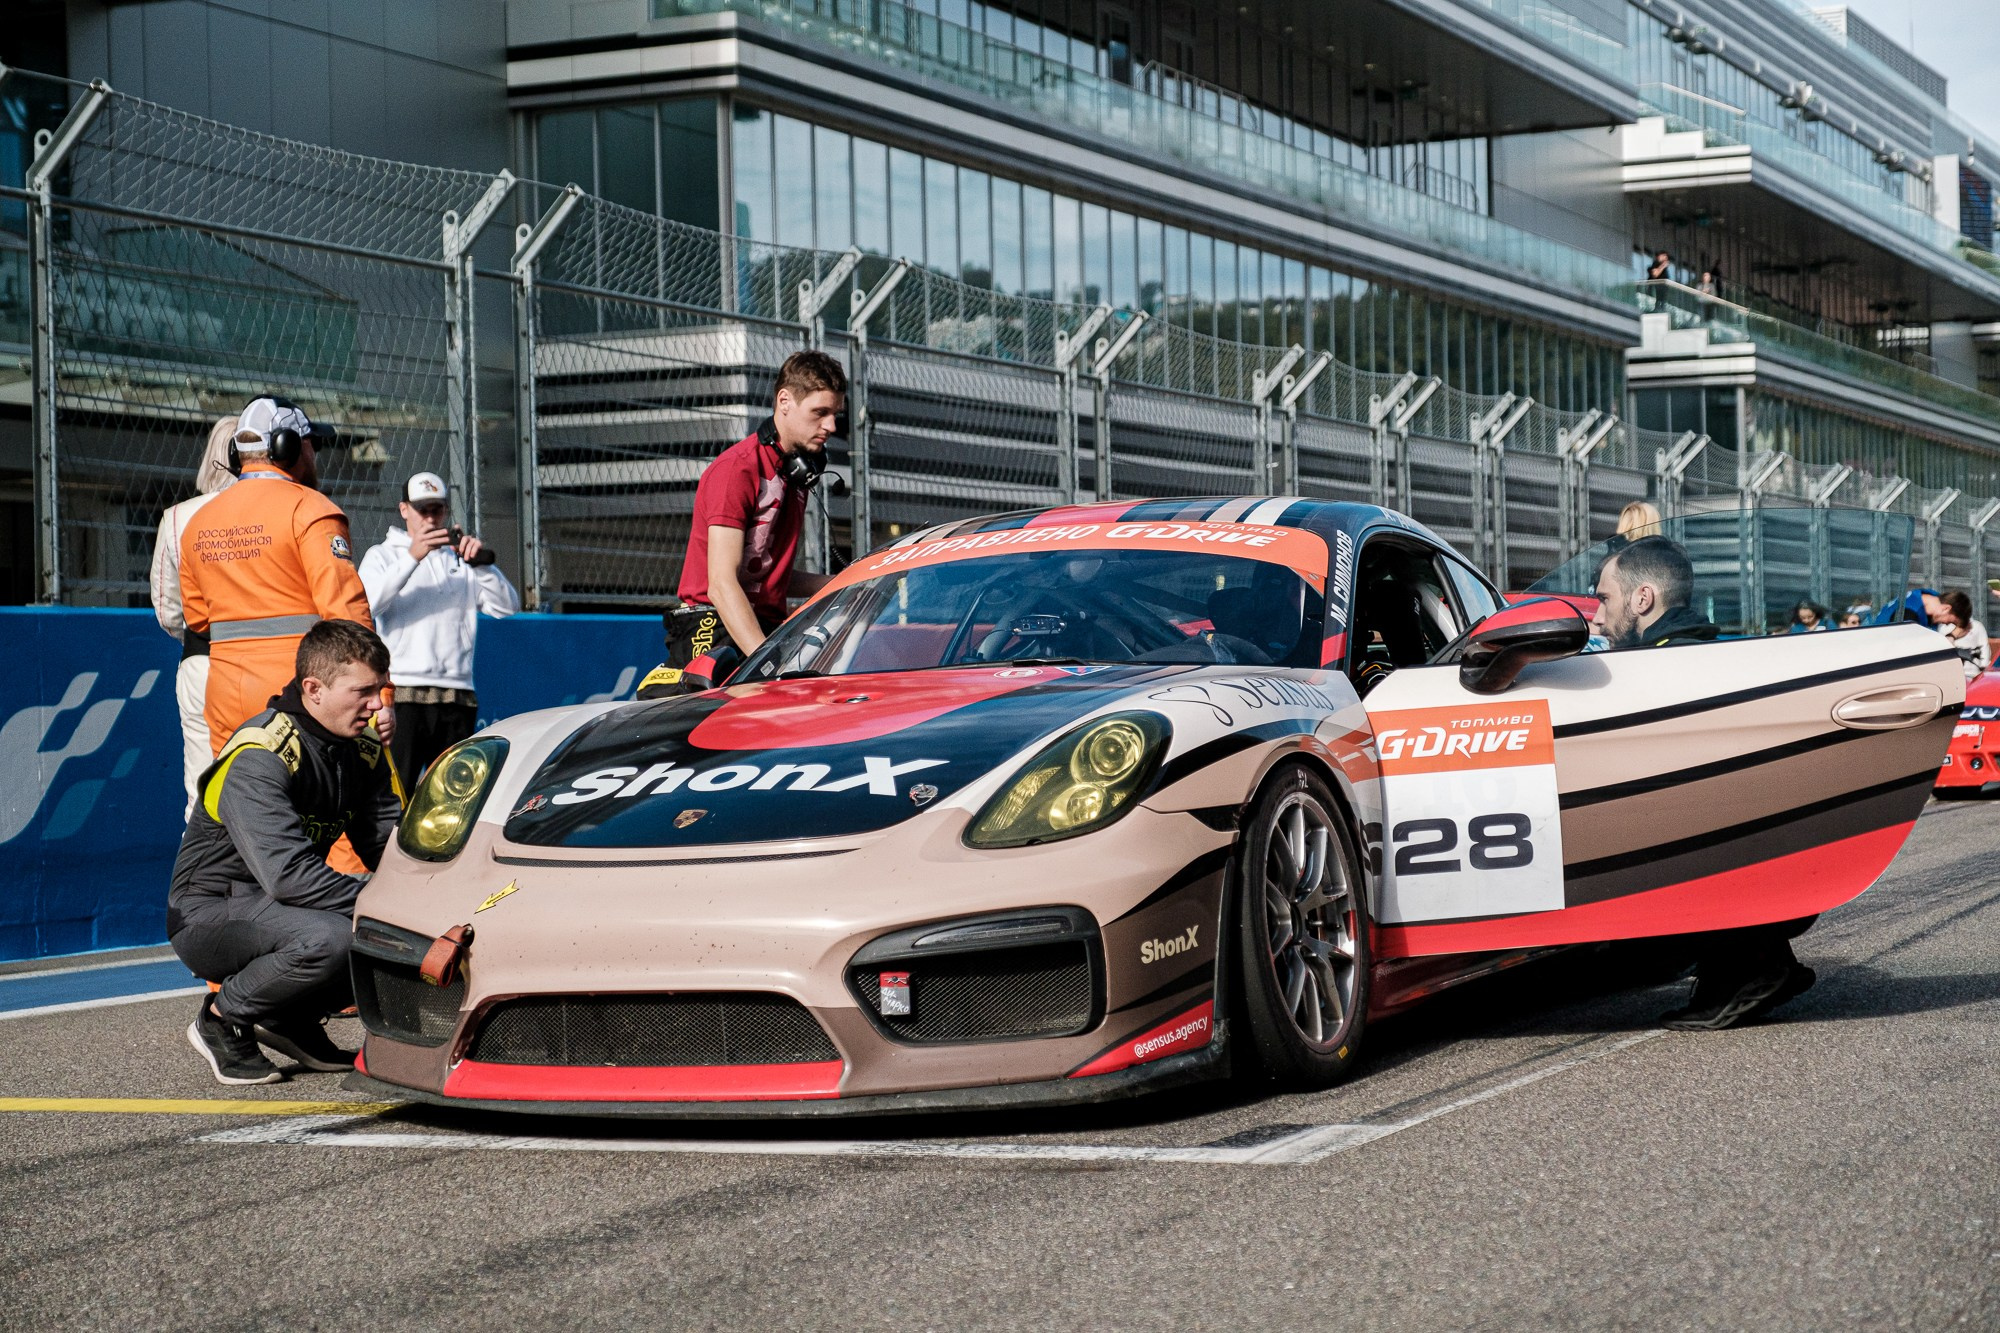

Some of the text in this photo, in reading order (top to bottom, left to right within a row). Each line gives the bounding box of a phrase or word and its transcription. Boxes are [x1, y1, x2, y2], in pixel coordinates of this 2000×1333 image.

[193, 536, 272, 552] автомобильная
[198, 525, 264, 542] российская
[1200, 523, 1289, 537] ТОПЛИВО
[200, 548, 261, 564] федерация
[869, 525, 1101, 571] ЗАПРАВЛЕНО
[1333, 529, 1353, 604] СИМОНОВ
[1210, 676, 1335, 711] Sensus
[1451, 714, 1534, 729] ТОПЛИВО
[1392, 813, 1534, 876] 28
[1140, 925, 1199, 964] ShonX
[1134, 1016, 1208, 1057] @sensus.agency
